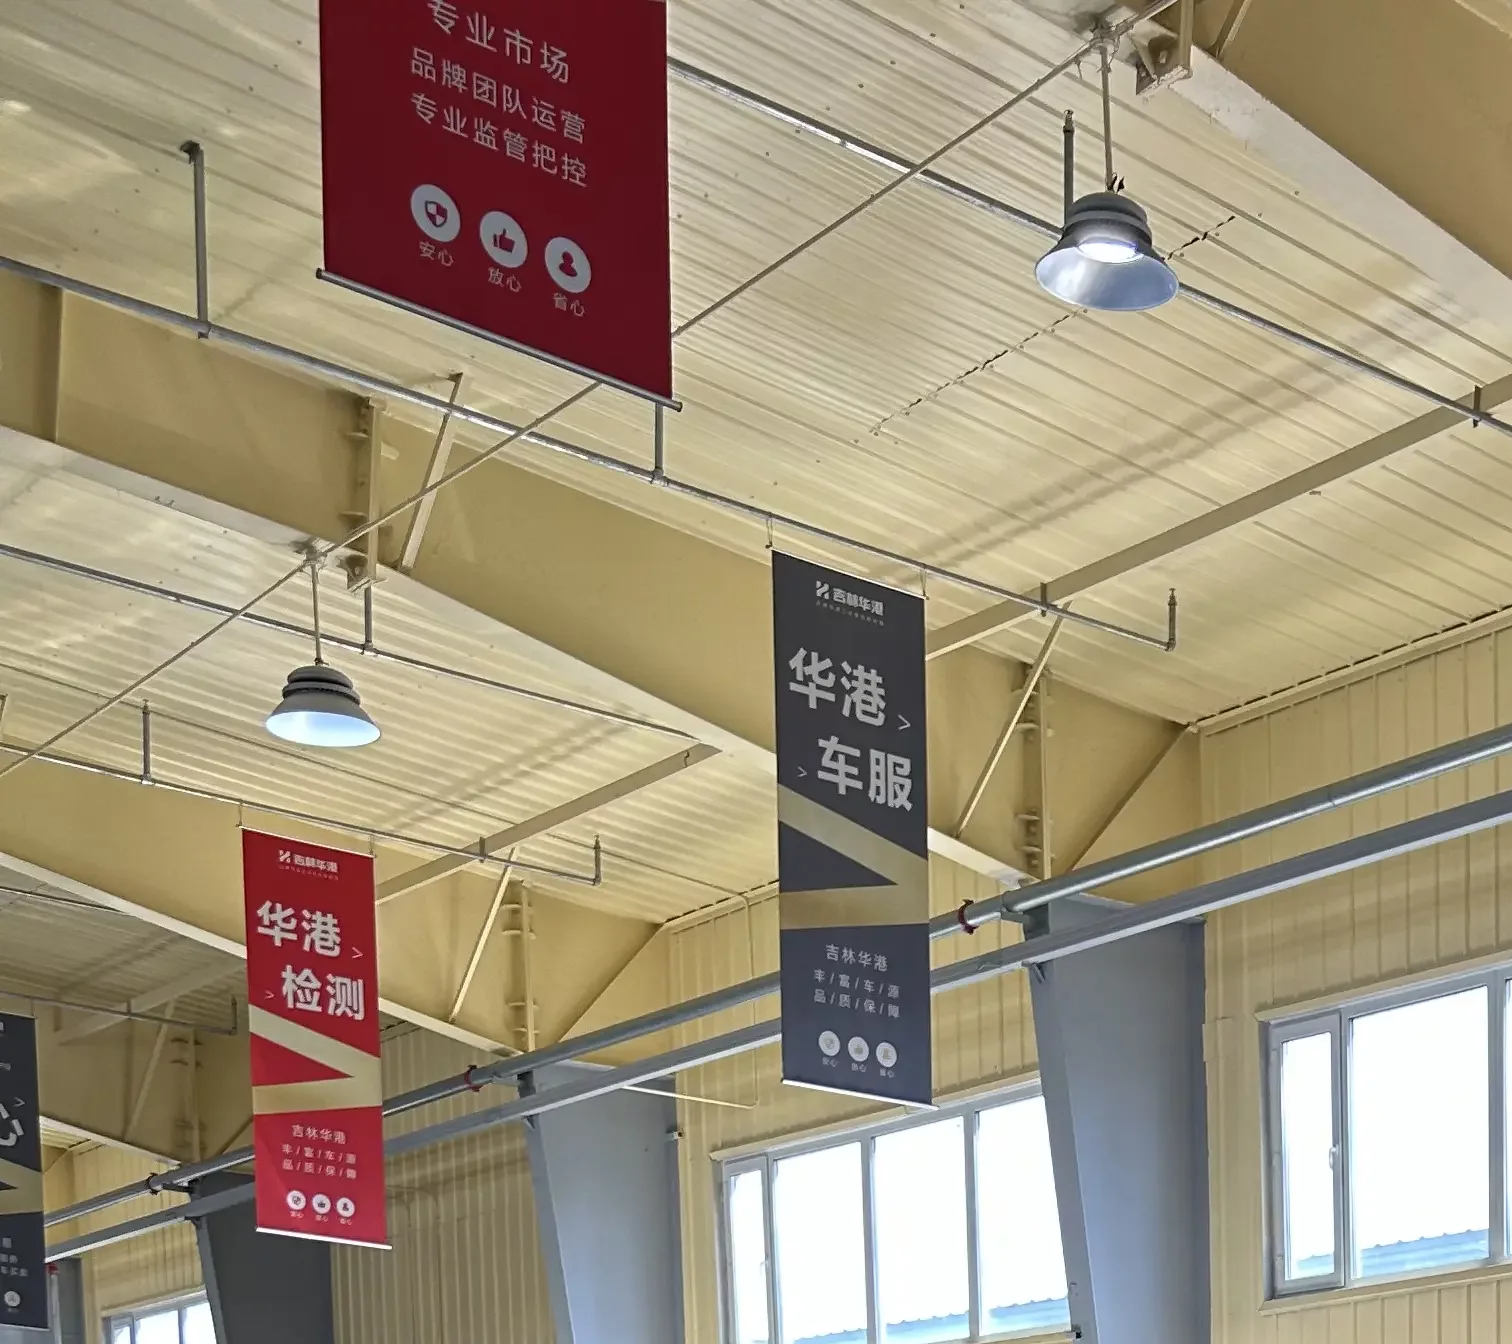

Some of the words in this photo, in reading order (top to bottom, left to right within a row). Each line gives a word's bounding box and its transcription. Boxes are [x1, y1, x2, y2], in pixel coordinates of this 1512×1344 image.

[427, 0, 569, 84] 专业市场
[411, 46, 586, 145] 品牌团队运营
[411, 92, 588, 188] 专业监管把控
[419, 241, 455, 267] 安心
[487, 267, 522, 293] 放心
[552, 292, 586, 318] 省心
[788, 647, 886, 727] 华港
[817, 735, 914, 812] 车服
[256, 900, 341, 958] 华港
[825, 944, 888, 972] 吉林华港
[280, 964, 366, 1021] 检测
